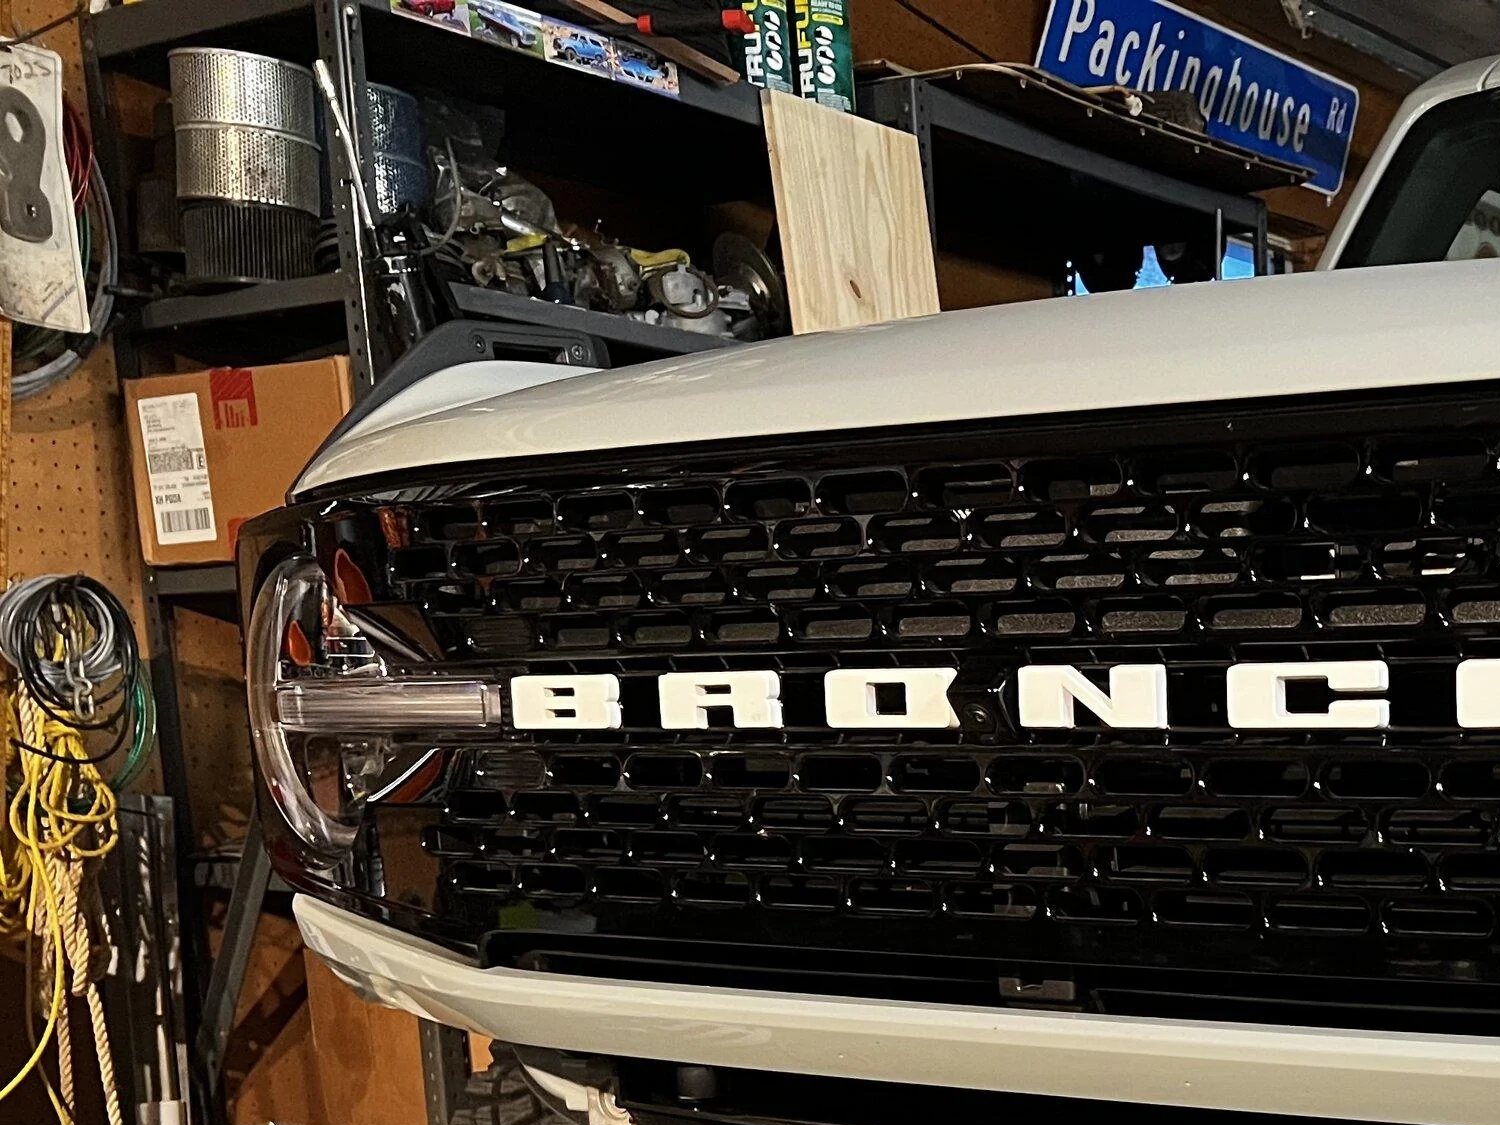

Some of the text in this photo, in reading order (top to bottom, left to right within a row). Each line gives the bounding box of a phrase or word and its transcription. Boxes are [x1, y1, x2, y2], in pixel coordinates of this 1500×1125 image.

[741, 0, 765, 88] TRU
[1058, 0, 1348, 152] Packinghouse Rd
